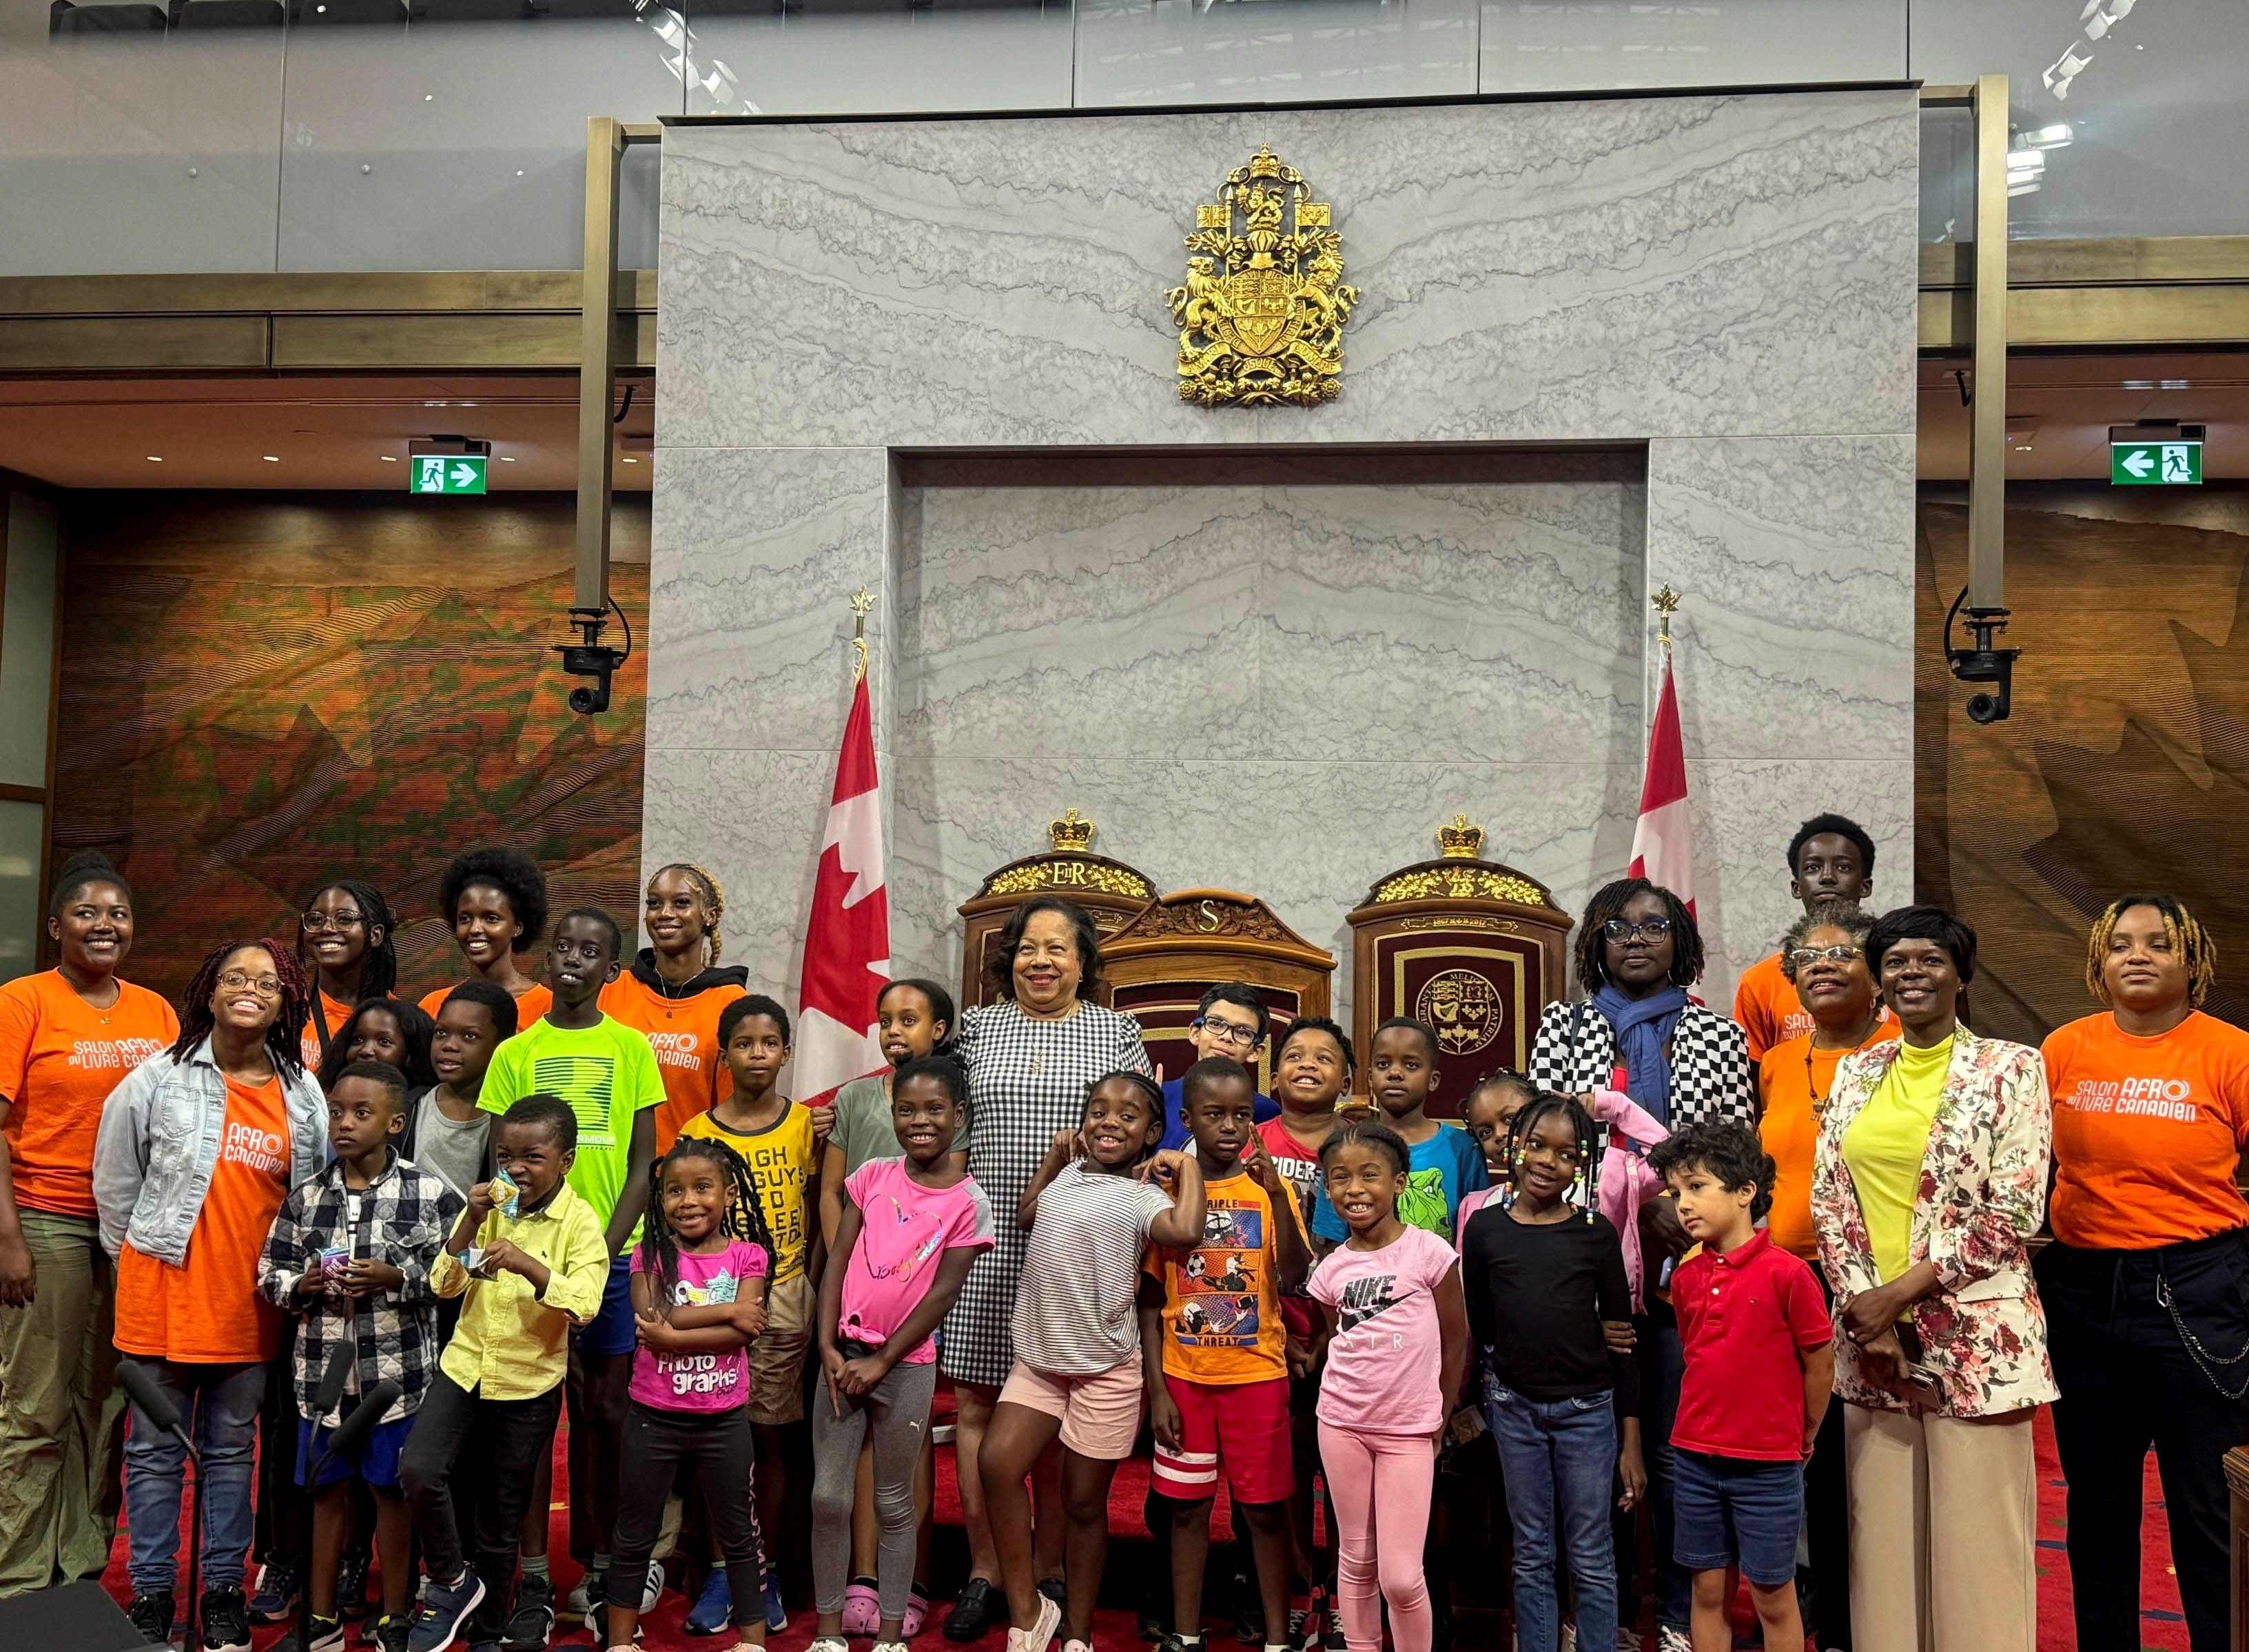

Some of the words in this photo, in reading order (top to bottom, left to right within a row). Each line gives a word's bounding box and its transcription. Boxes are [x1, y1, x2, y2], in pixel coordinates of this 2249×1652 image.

[1243, 357, 1275, 371] USQUE
[1199, 899, 1219, 931] S
[1475, 1008, 1499, 1048] PATRIAM
[2119, 1077, 2190, 1102] AFRO
[227, 1122, 283, 1155] AFRO
[1207, 1199, 1238, 1209] RIPLE
[1343, 1275, 1397, 1309] NIKE
[1198, 1336, 1239, 1347] THREAT
